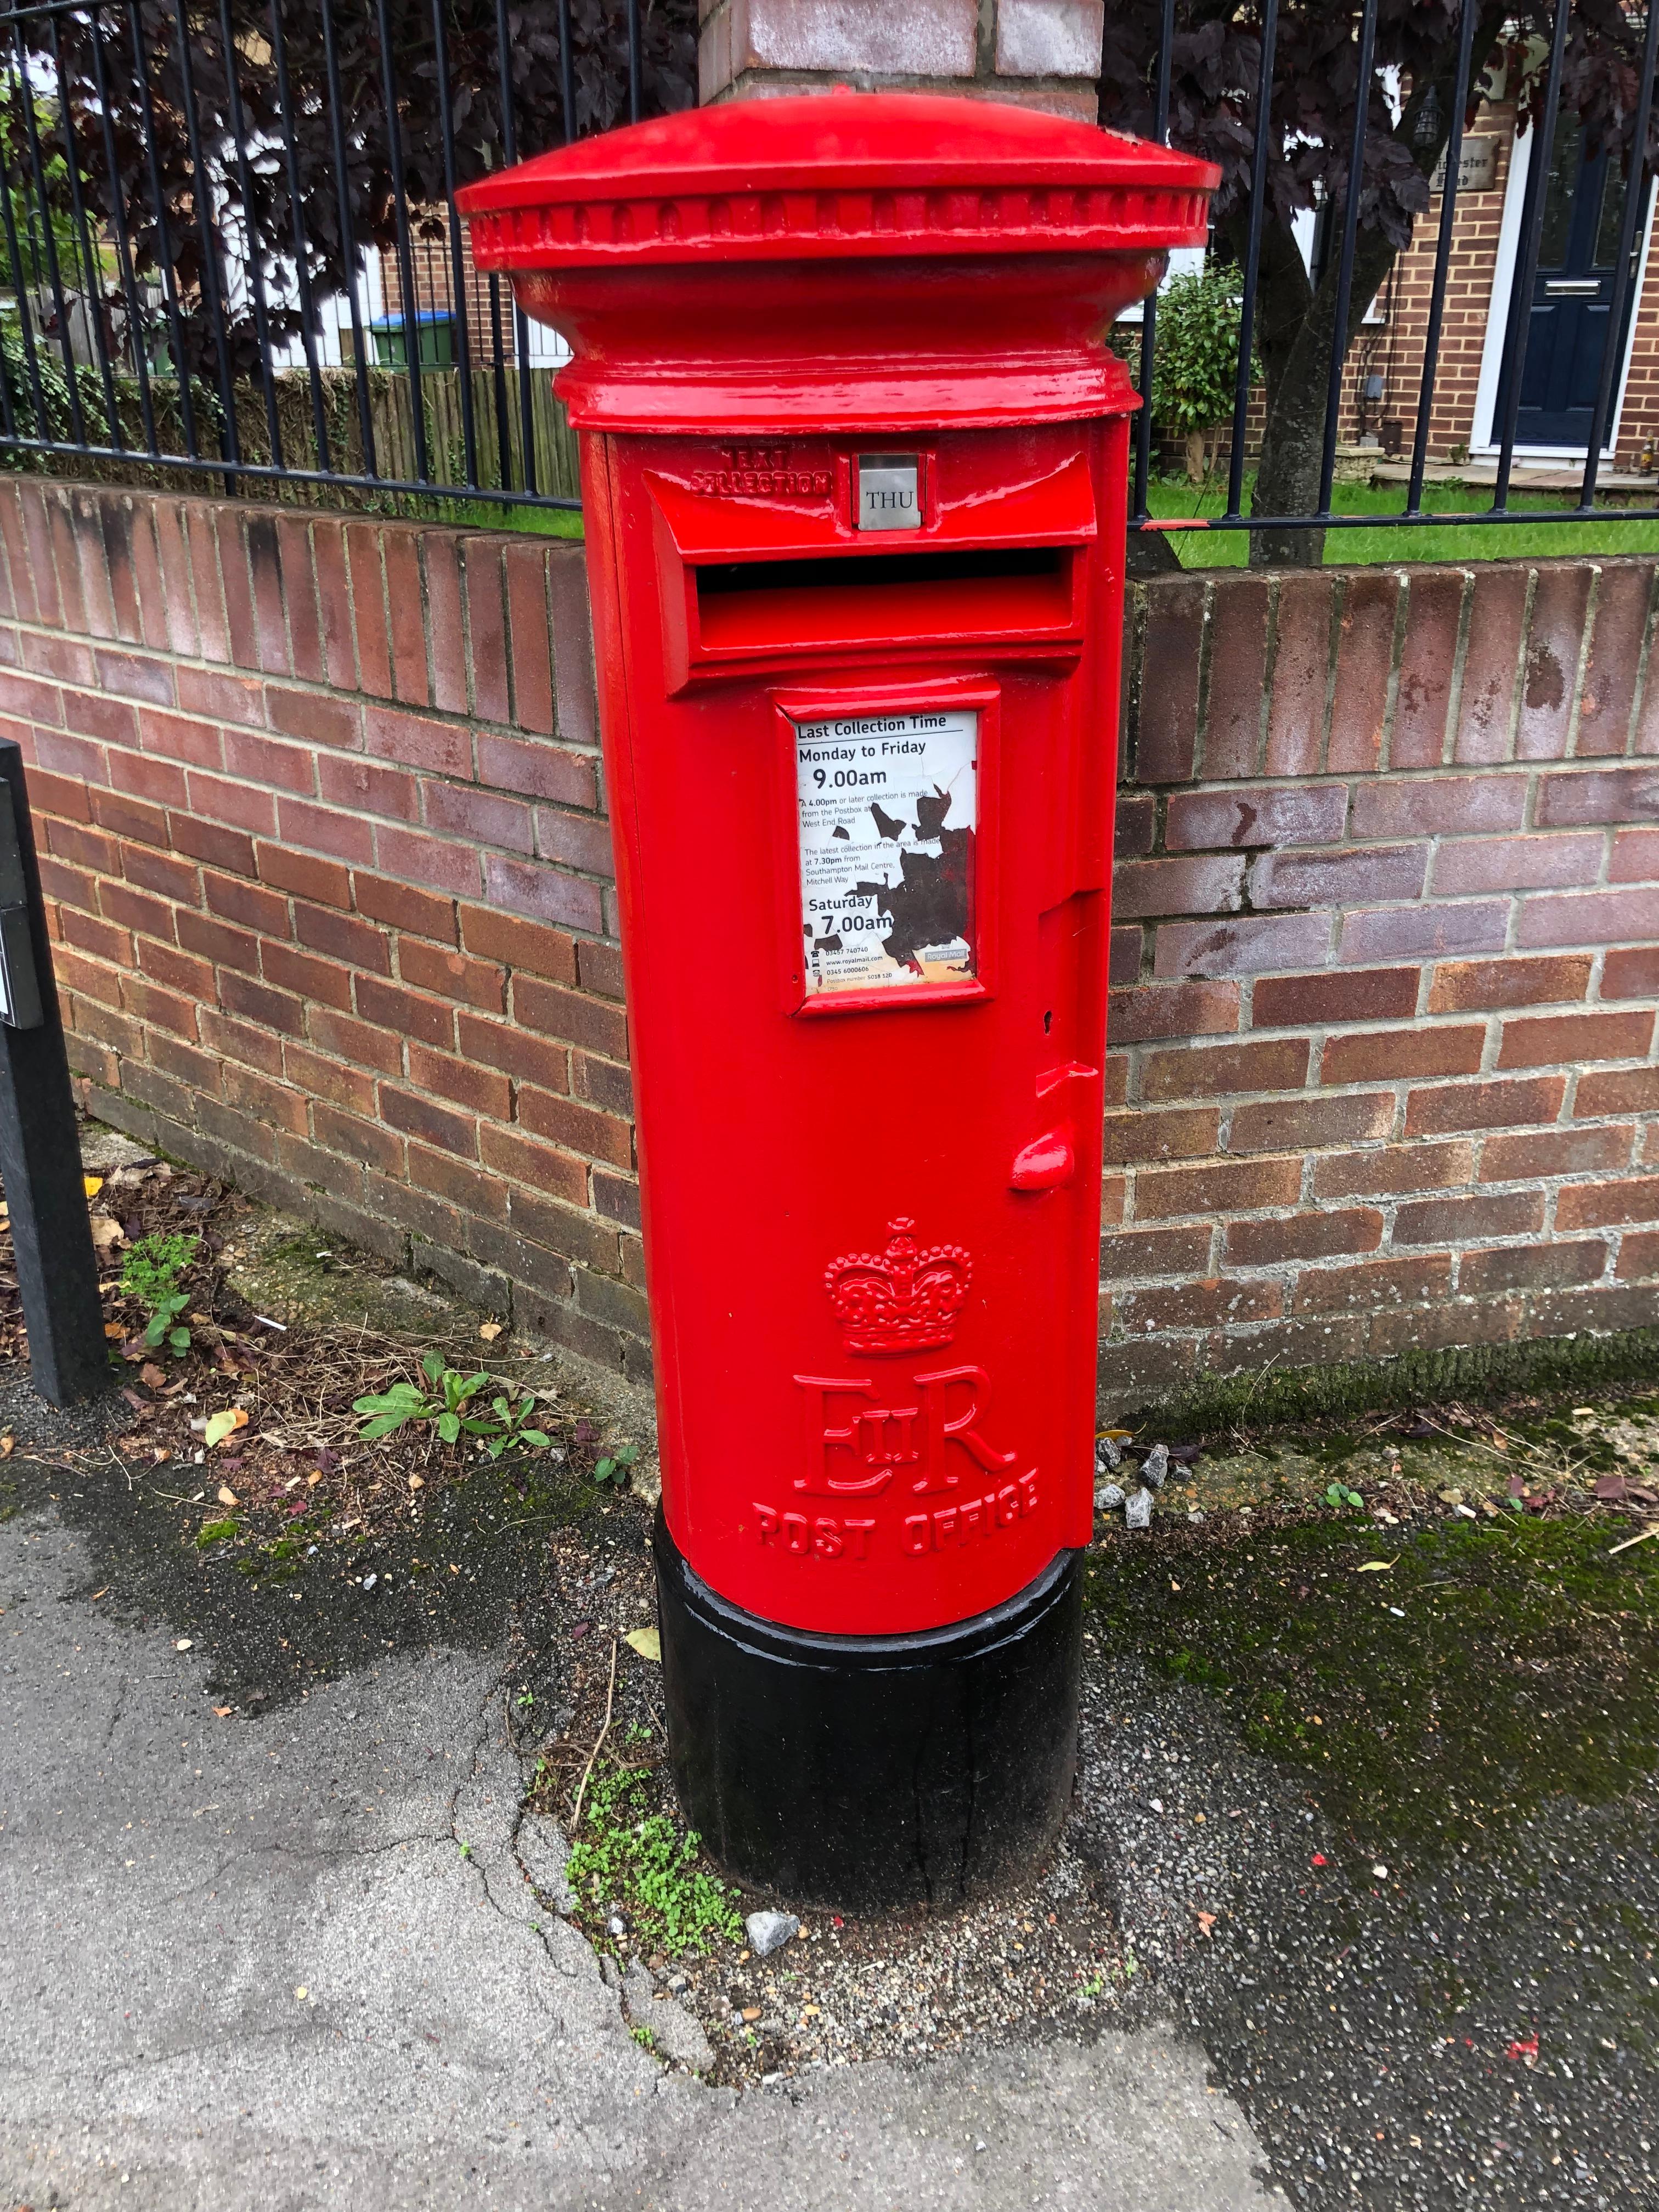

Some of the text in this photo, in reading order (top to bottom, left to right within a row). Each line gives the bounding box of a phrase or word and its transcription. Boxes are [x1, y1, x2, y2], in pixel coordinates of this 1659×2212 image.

[691, 472, 832, 495] COLLECTION
[866, 491, 914, 510] THU
[798, 716, 946, 739] Last Collection Time
[799, 741, 926, 763] Monday to Friday
[813, 769, 887, 789] 9.00am
[809, 799, 837, 808] 4.00pm
[849, 795, 864, 804] later
[867, 793, 899, 802] collection
[909, 789, 928, 798] made
[835, 806, 862, 814] Postbox
[820, 847, 838, 855] latest
[840, 843, 872, 854] collection
[883, 840, 894, 849] the
[921, 837, 940, 845] made
[806, 861, 895, 877] Southampton Mail Centre,
[815, 857, 842, 866] 7.30pm
[844, 854, 861, 862] from
[806, 876, 832, 885] Mitchell
[809, 895, 873, 911] Saturday
[821, 915, 892, 935] 7.00am
[826, 956, 883, 966] www.royalmail.com
[927, 952, 947, 960] Royal
[752, 1468, 1039, 1559] POST OFFICE
